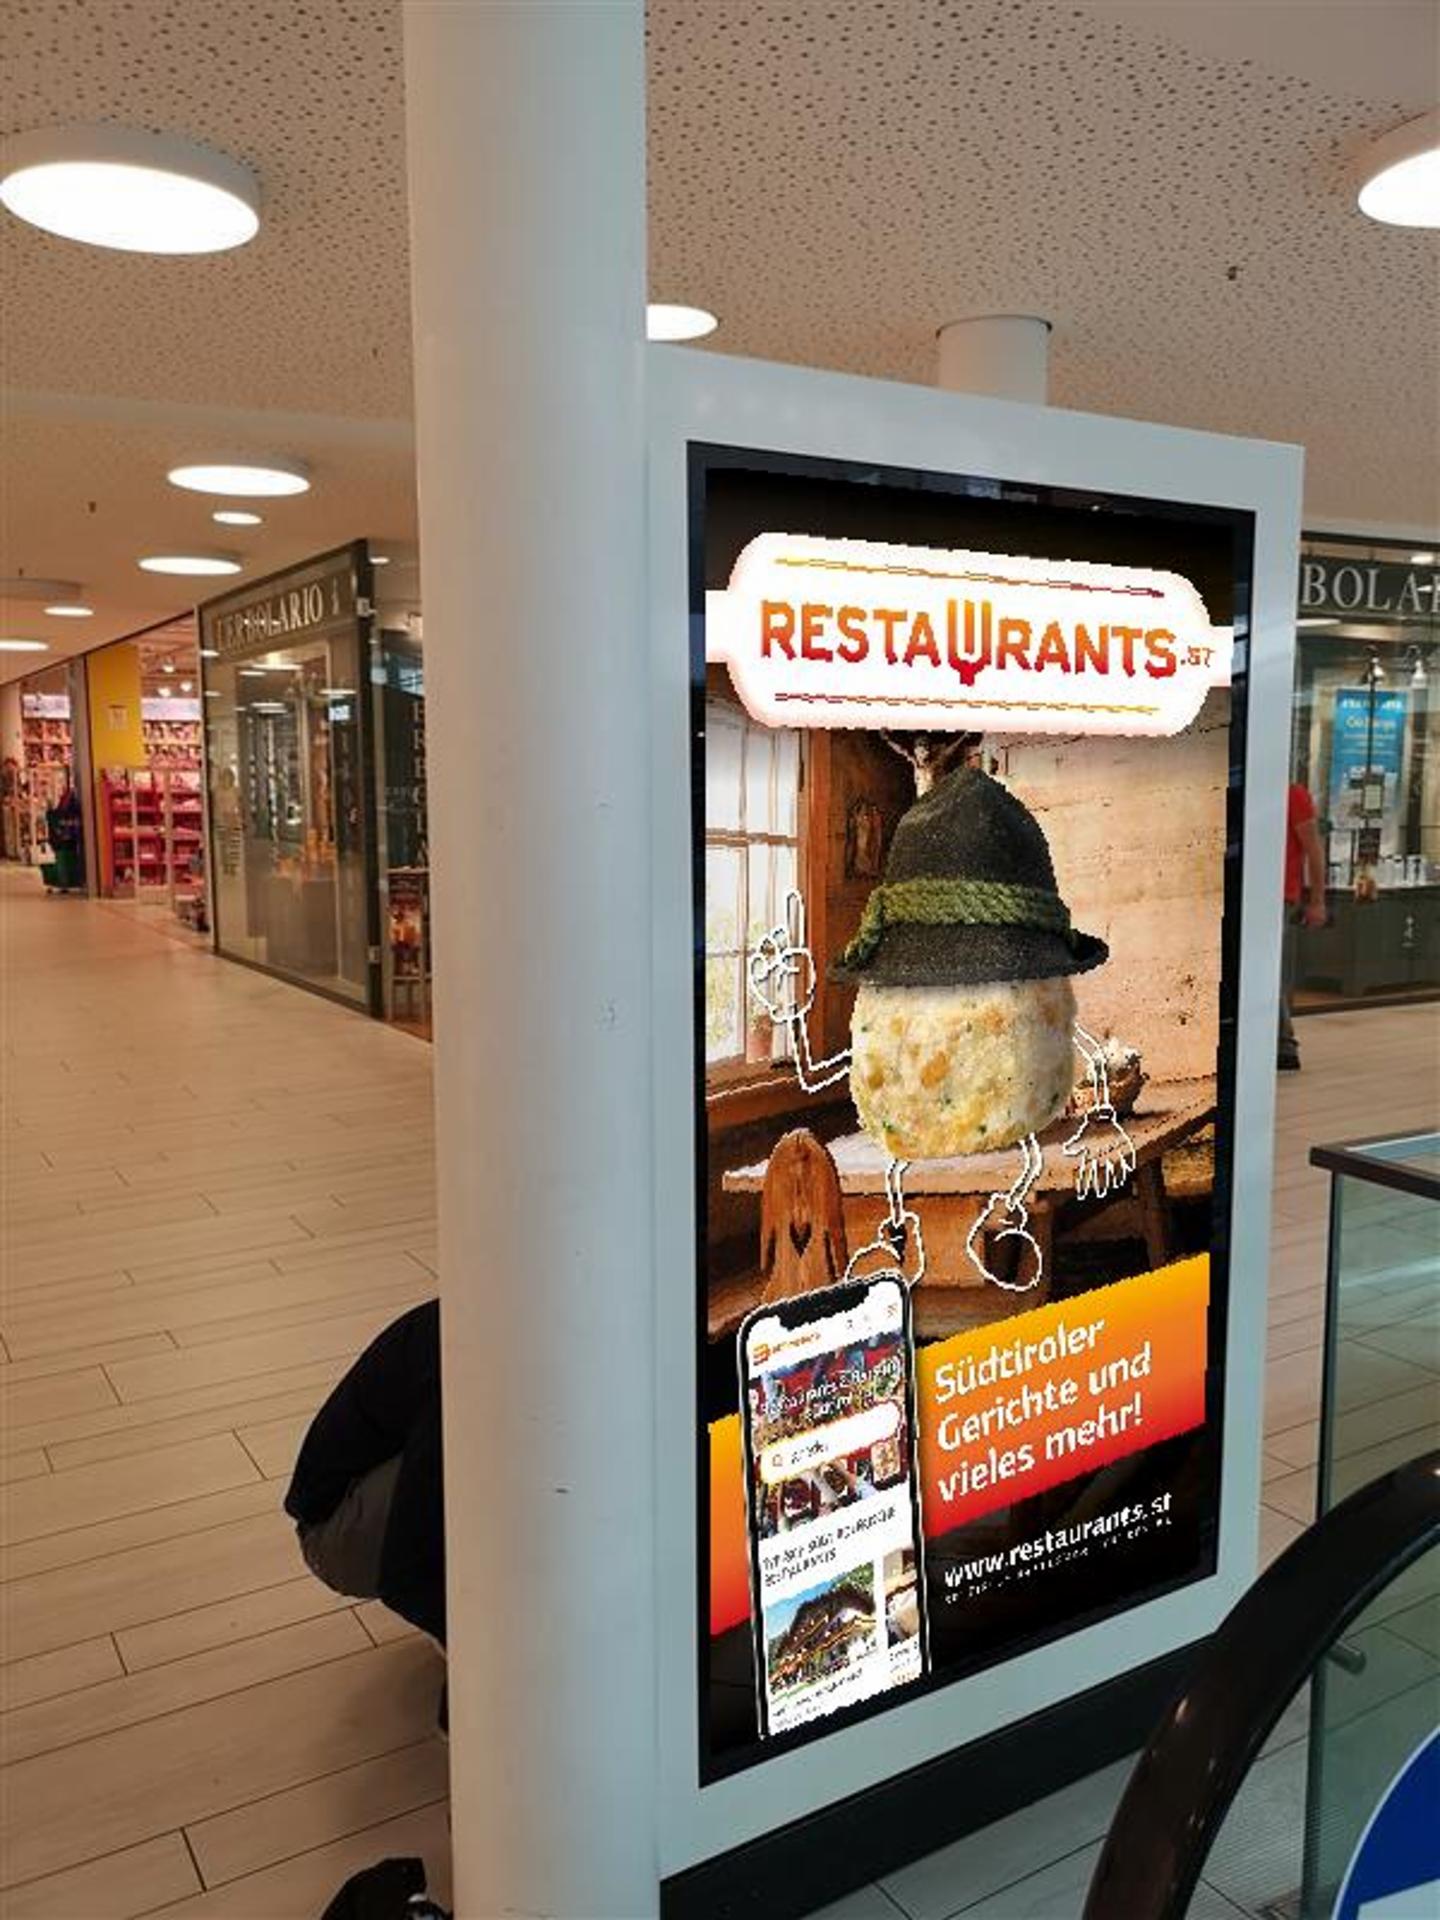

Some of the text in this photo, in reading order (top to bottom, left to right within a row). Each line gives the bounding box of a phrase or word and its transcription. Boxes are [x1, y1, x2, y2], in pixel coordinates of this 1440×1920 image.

[935, 1319, 1105, 1404] Südtiroler
[937, 1377, 1078, 1451] Gerichte
[1088, 1341, 1151, 1396] und
[937, 1392, 1143, 1502] vieles mehr!
[944, 1492, 1172, 1588] www.restaurants.st
